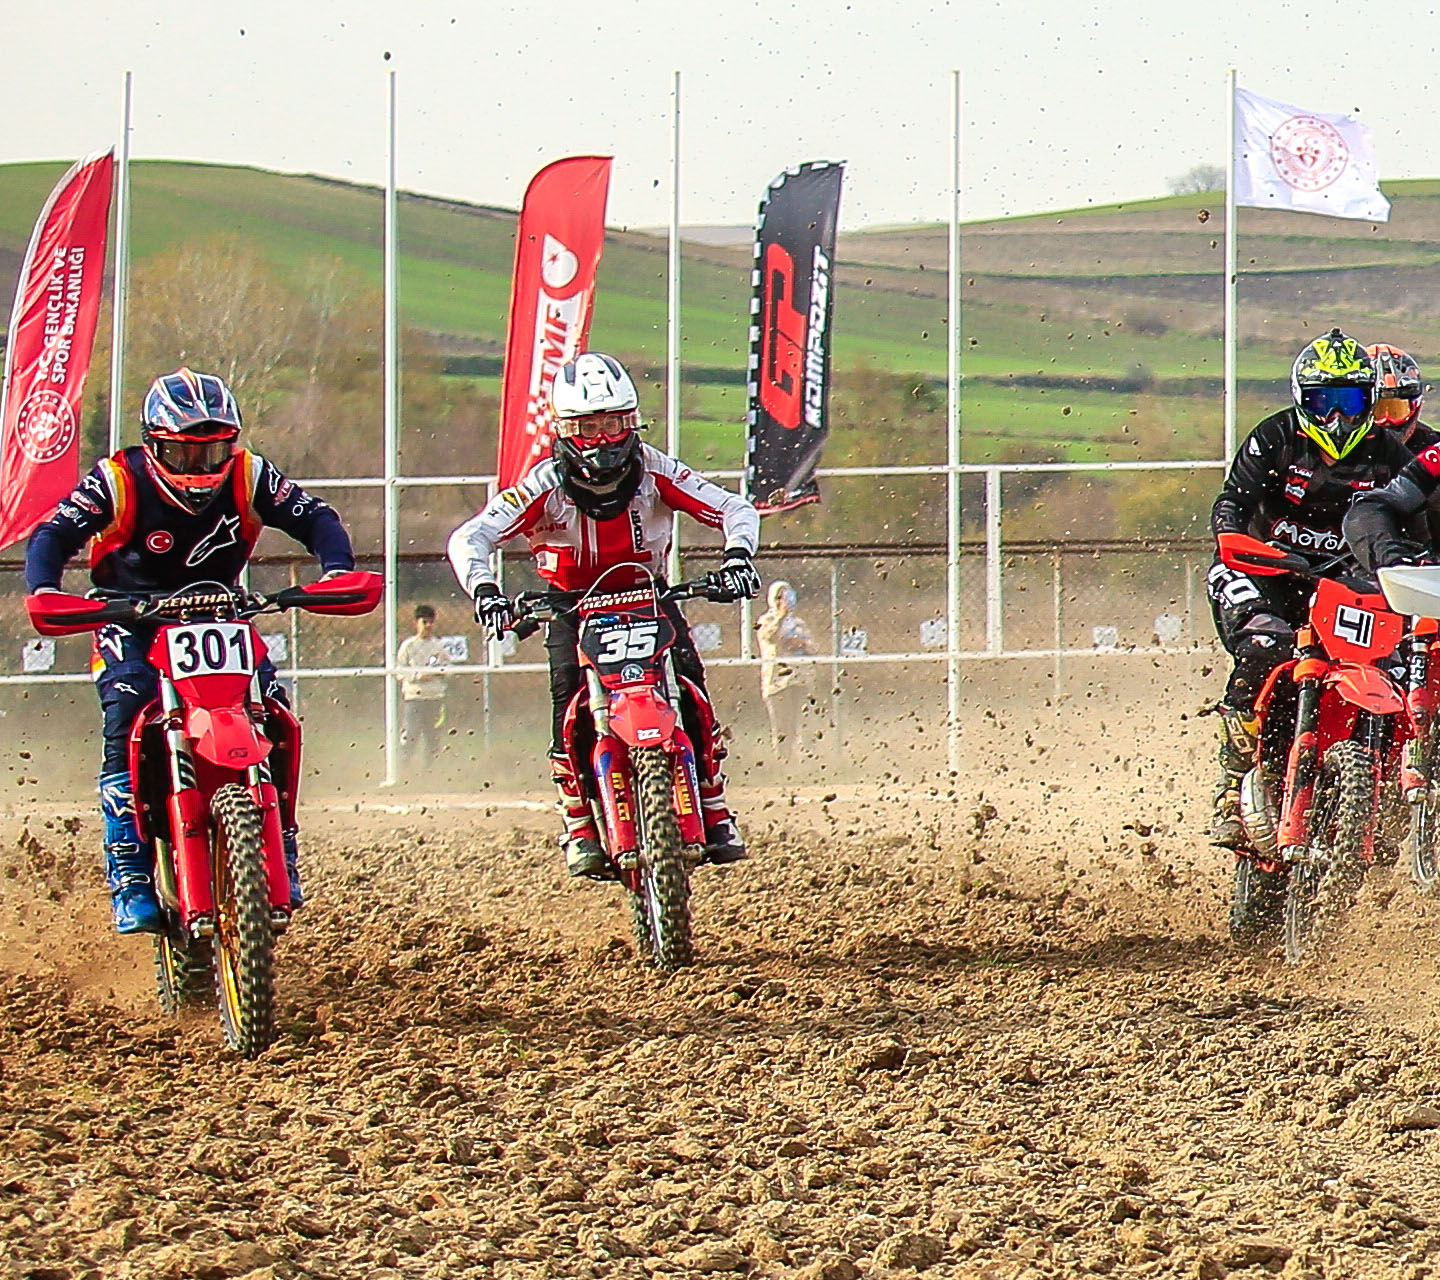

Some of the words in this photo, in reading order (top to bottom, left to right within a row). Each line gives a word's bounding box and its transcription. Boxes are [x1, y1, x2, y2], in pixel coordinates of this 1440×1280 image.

[54, 246, 67, 270] VE
[51, 338, 72, 384] SPOR
[174, 629, 251, 673] 301
[598, 625, 658, 664] 35
